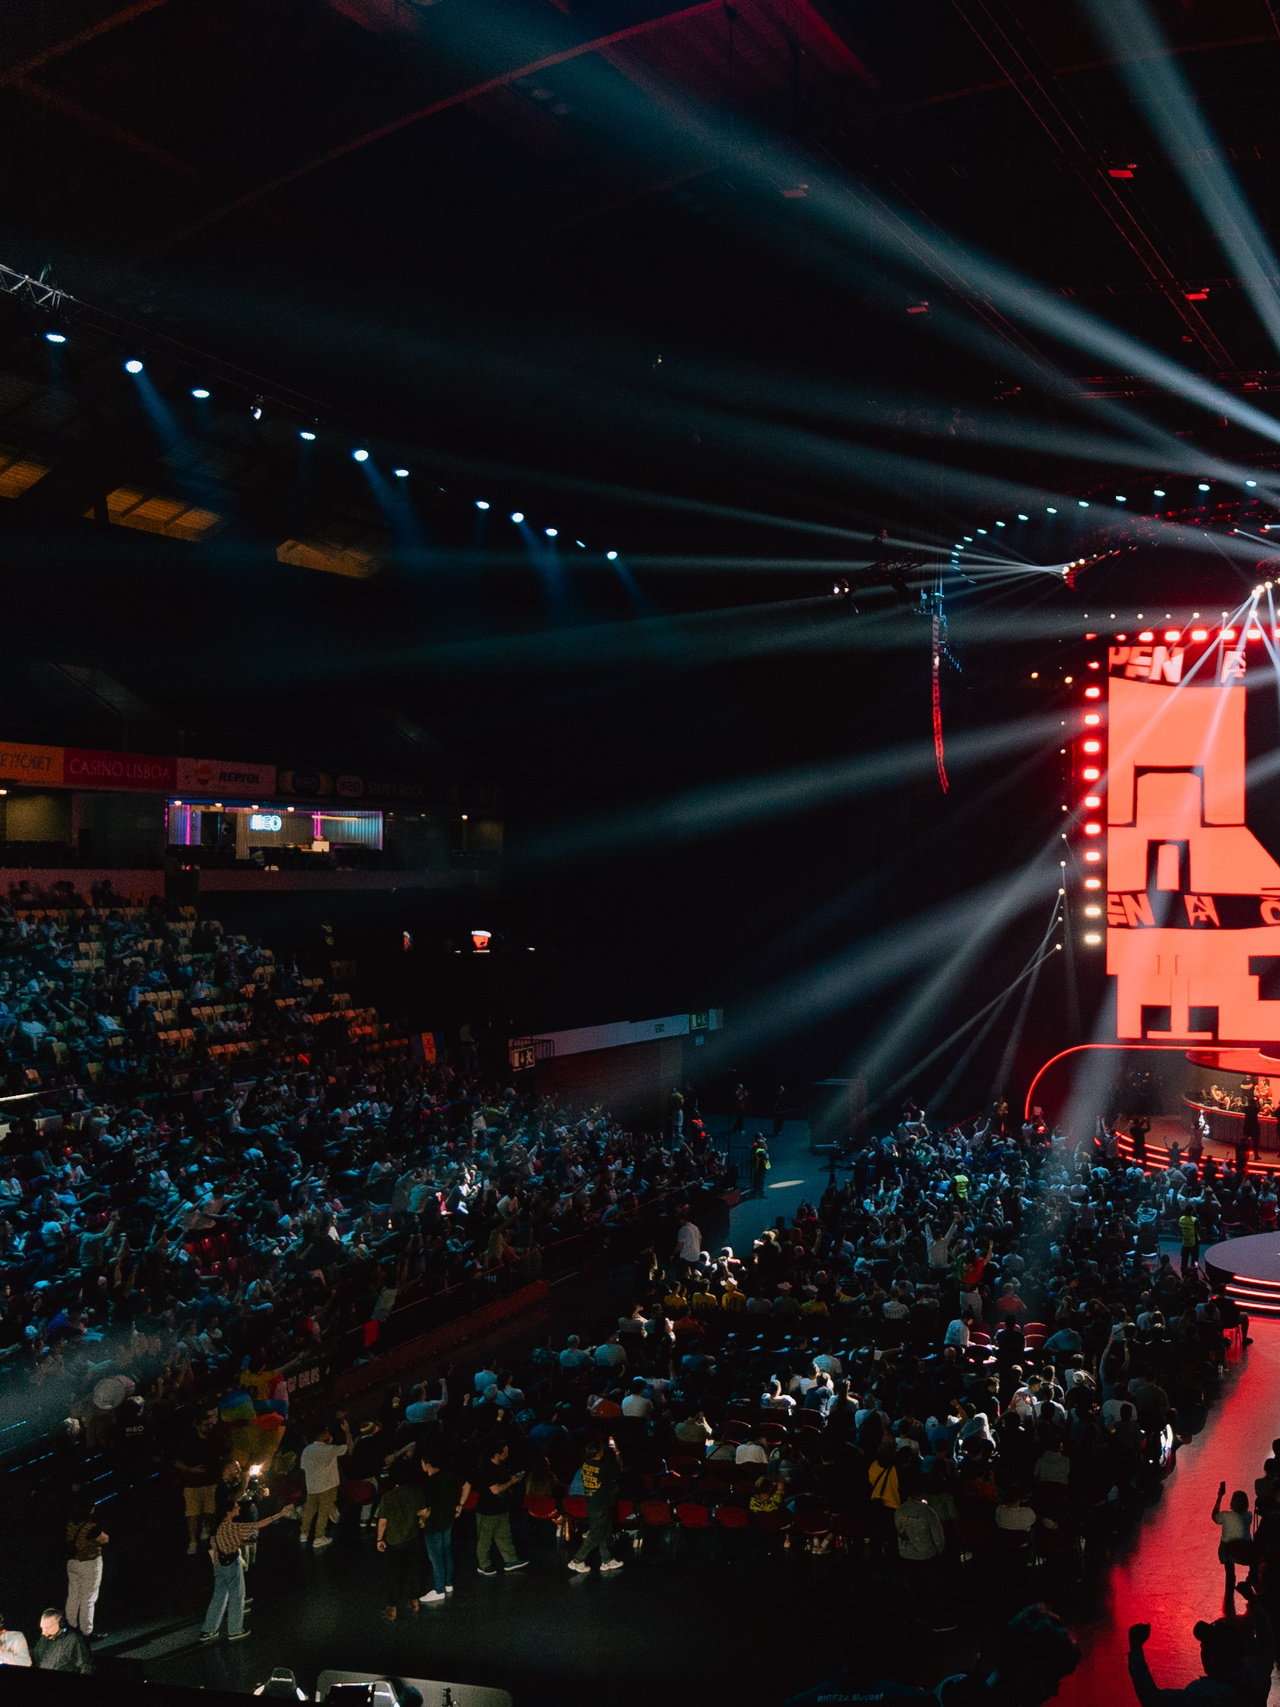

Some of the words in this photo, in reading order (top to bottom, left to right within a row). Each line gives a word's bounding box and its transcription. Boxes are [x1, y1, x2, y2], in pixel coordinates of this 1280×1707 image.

[70, 758, 123, 777] CASINO
[126, 763, 171, 780] LISBOA
[219, 771, 261, 785] REPSOL
